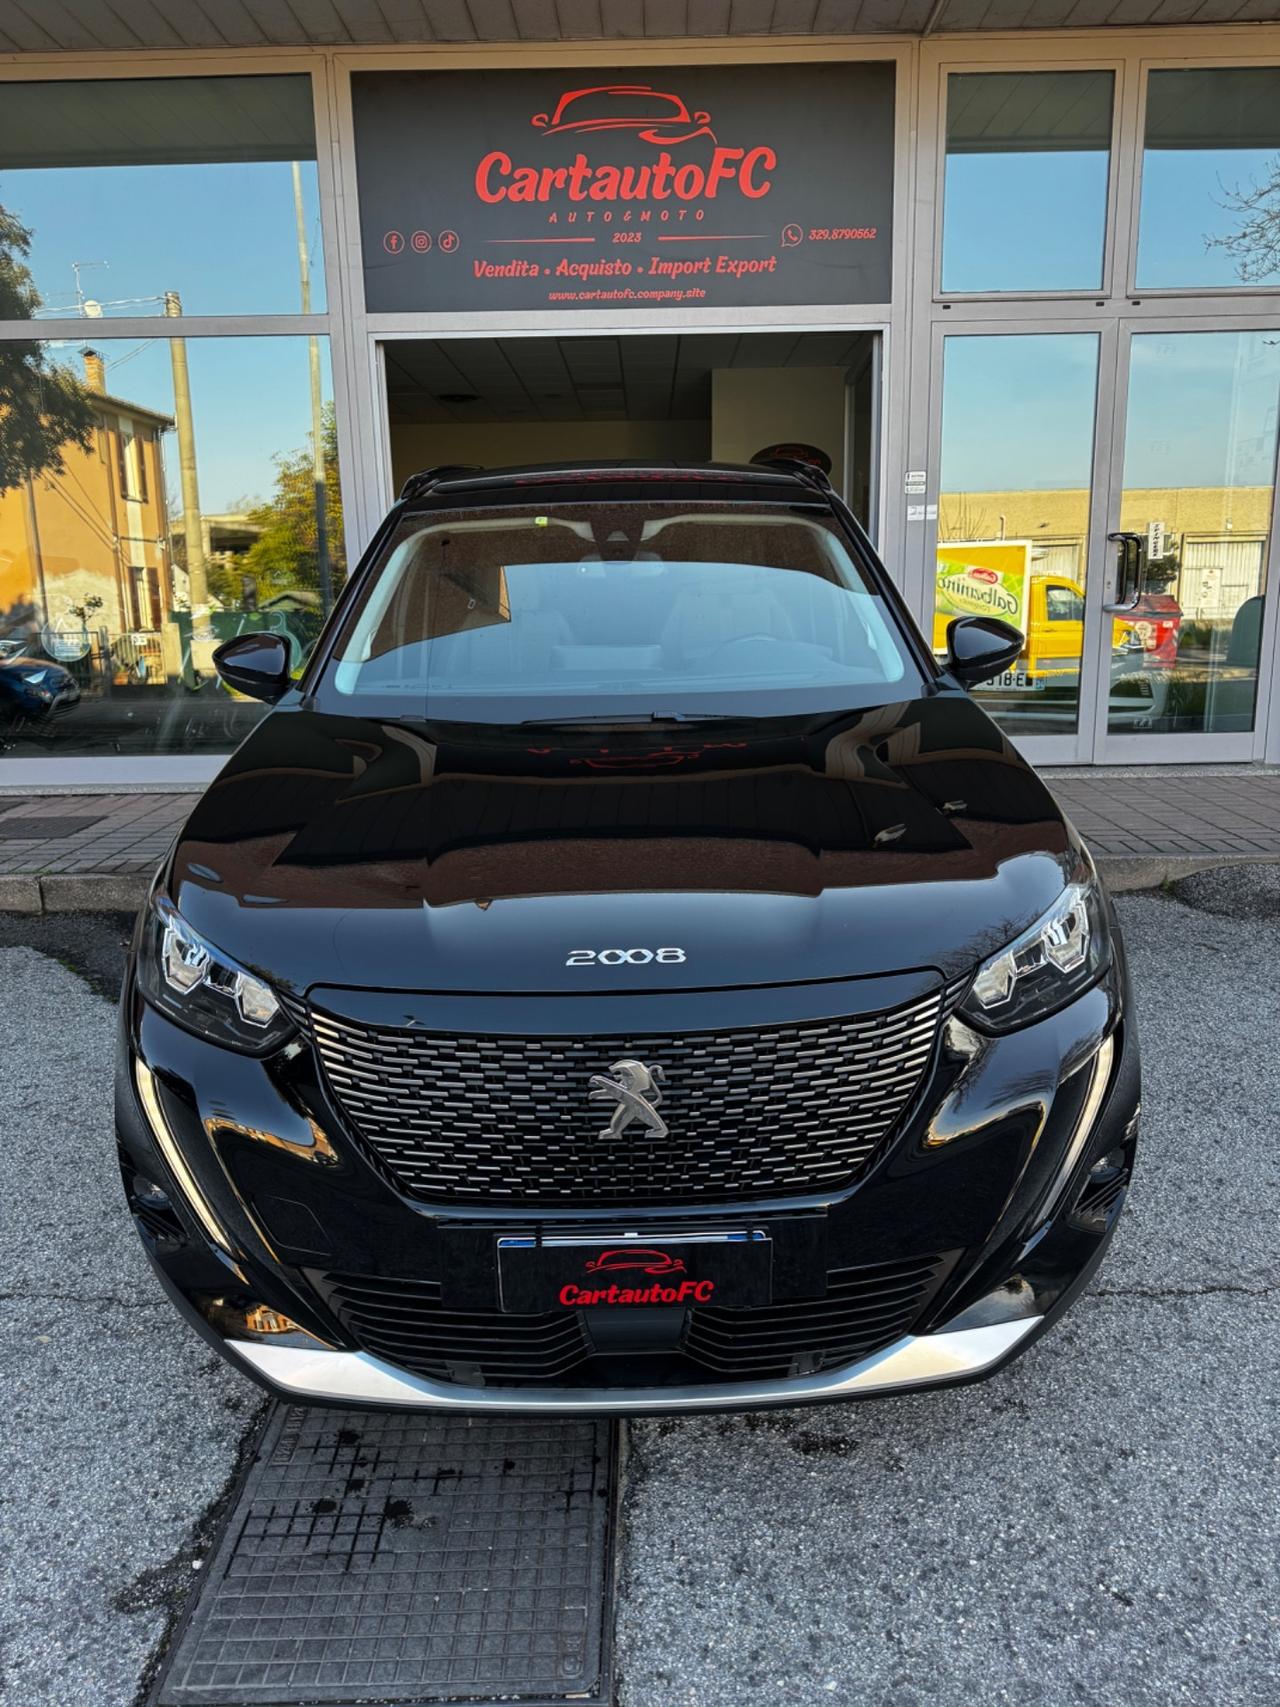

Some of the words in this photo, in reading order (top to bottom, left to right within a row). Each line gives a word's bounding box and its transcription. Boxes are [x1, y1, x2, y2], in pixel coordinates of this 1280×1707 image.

[474, 146, 777, 204] CartautoFC
[612, 232, 642, 243] 2023
[808, 228, 877, 240] 329.8790562
[473, 260, 539, 278] Vendita
[555, 258, 632, 281] Acquisto
[648, 256, 710, 280] Import
[715, 255, 777, 279] Export
[549, 287, 706, 302] www.cartautofc.company.site
[565, 948, 687, 966] 2008
[559, 1280, 715, 1306] CartautoFC
